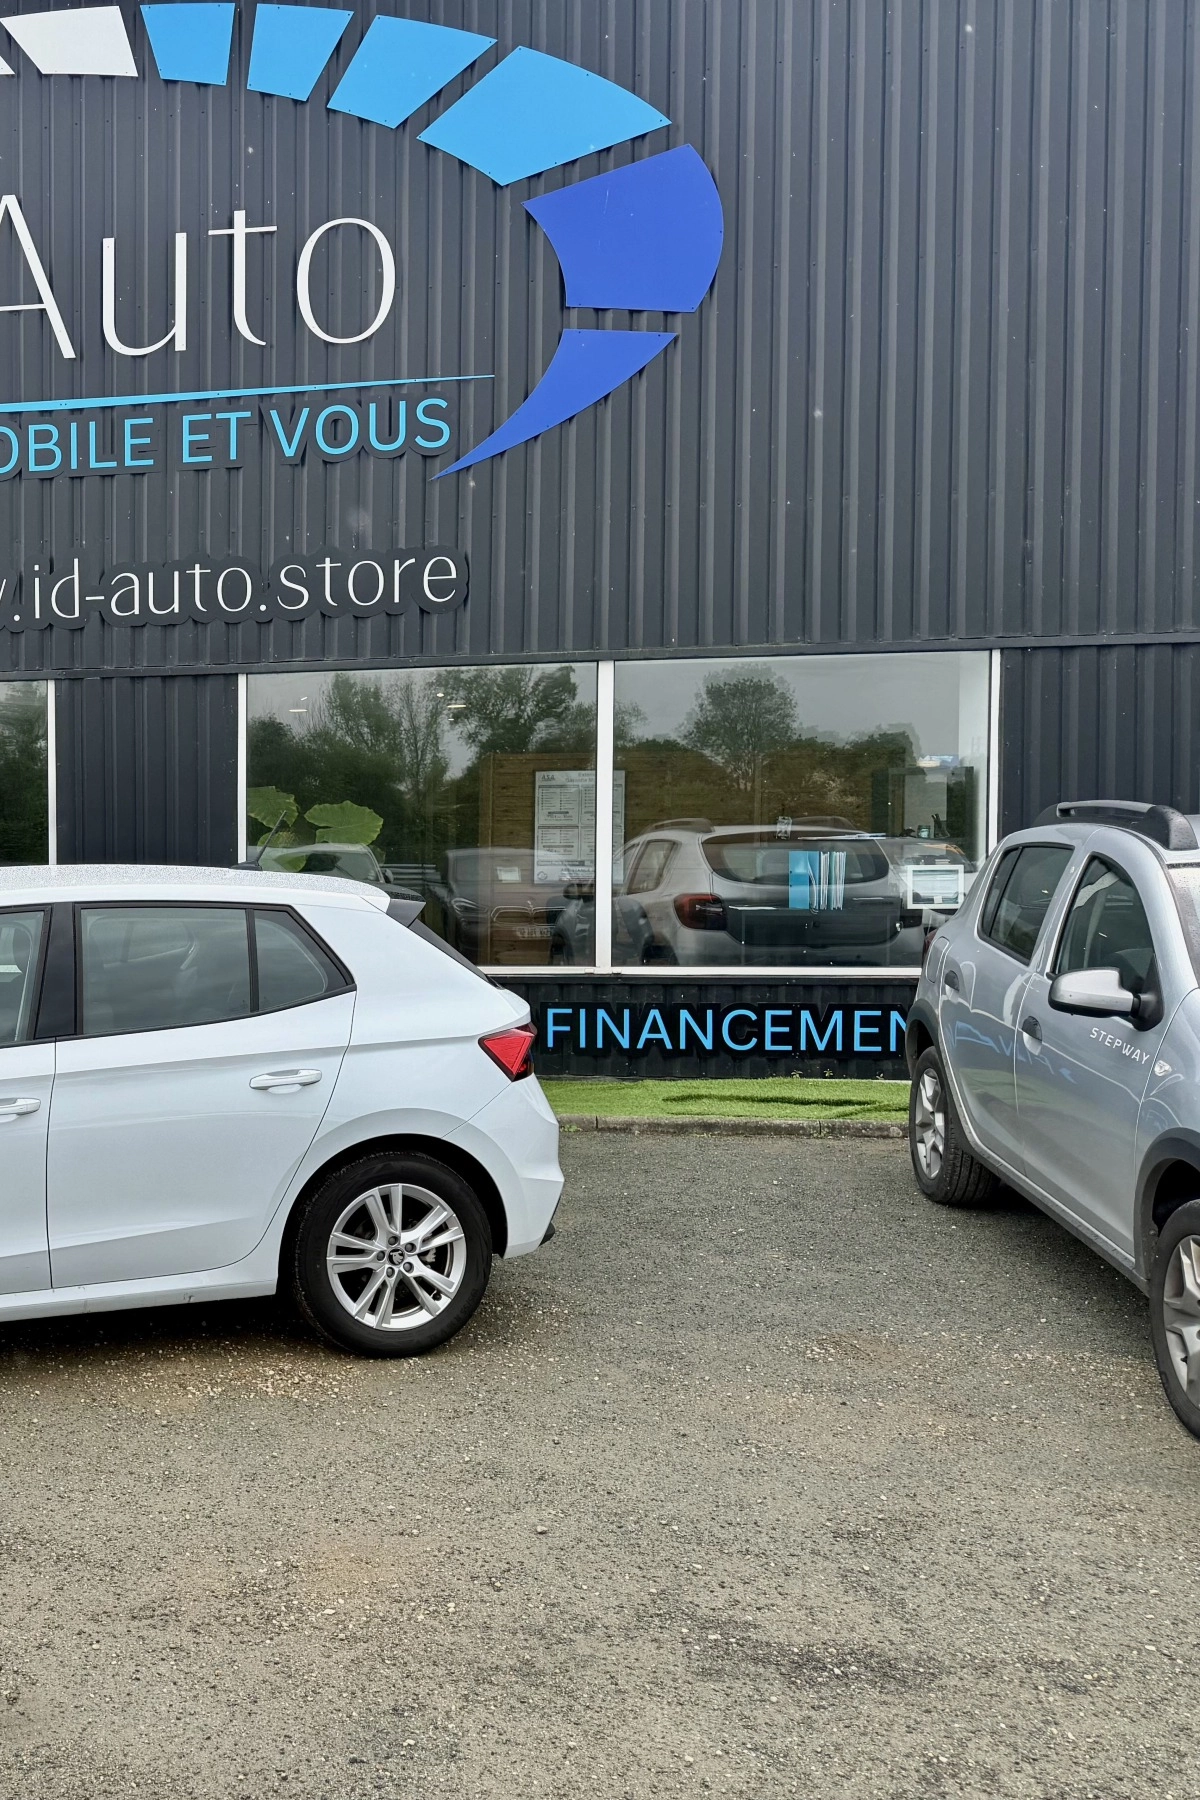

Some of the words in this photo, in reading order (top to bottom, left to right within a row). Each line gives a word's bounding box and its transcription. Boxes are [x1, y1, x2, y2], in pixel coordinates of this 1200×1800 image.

[181, 410, 252, 463] ET
[270, 397, 451, 457] VOUS
[1089, 1027, 1151, 1065] STEPWAY
